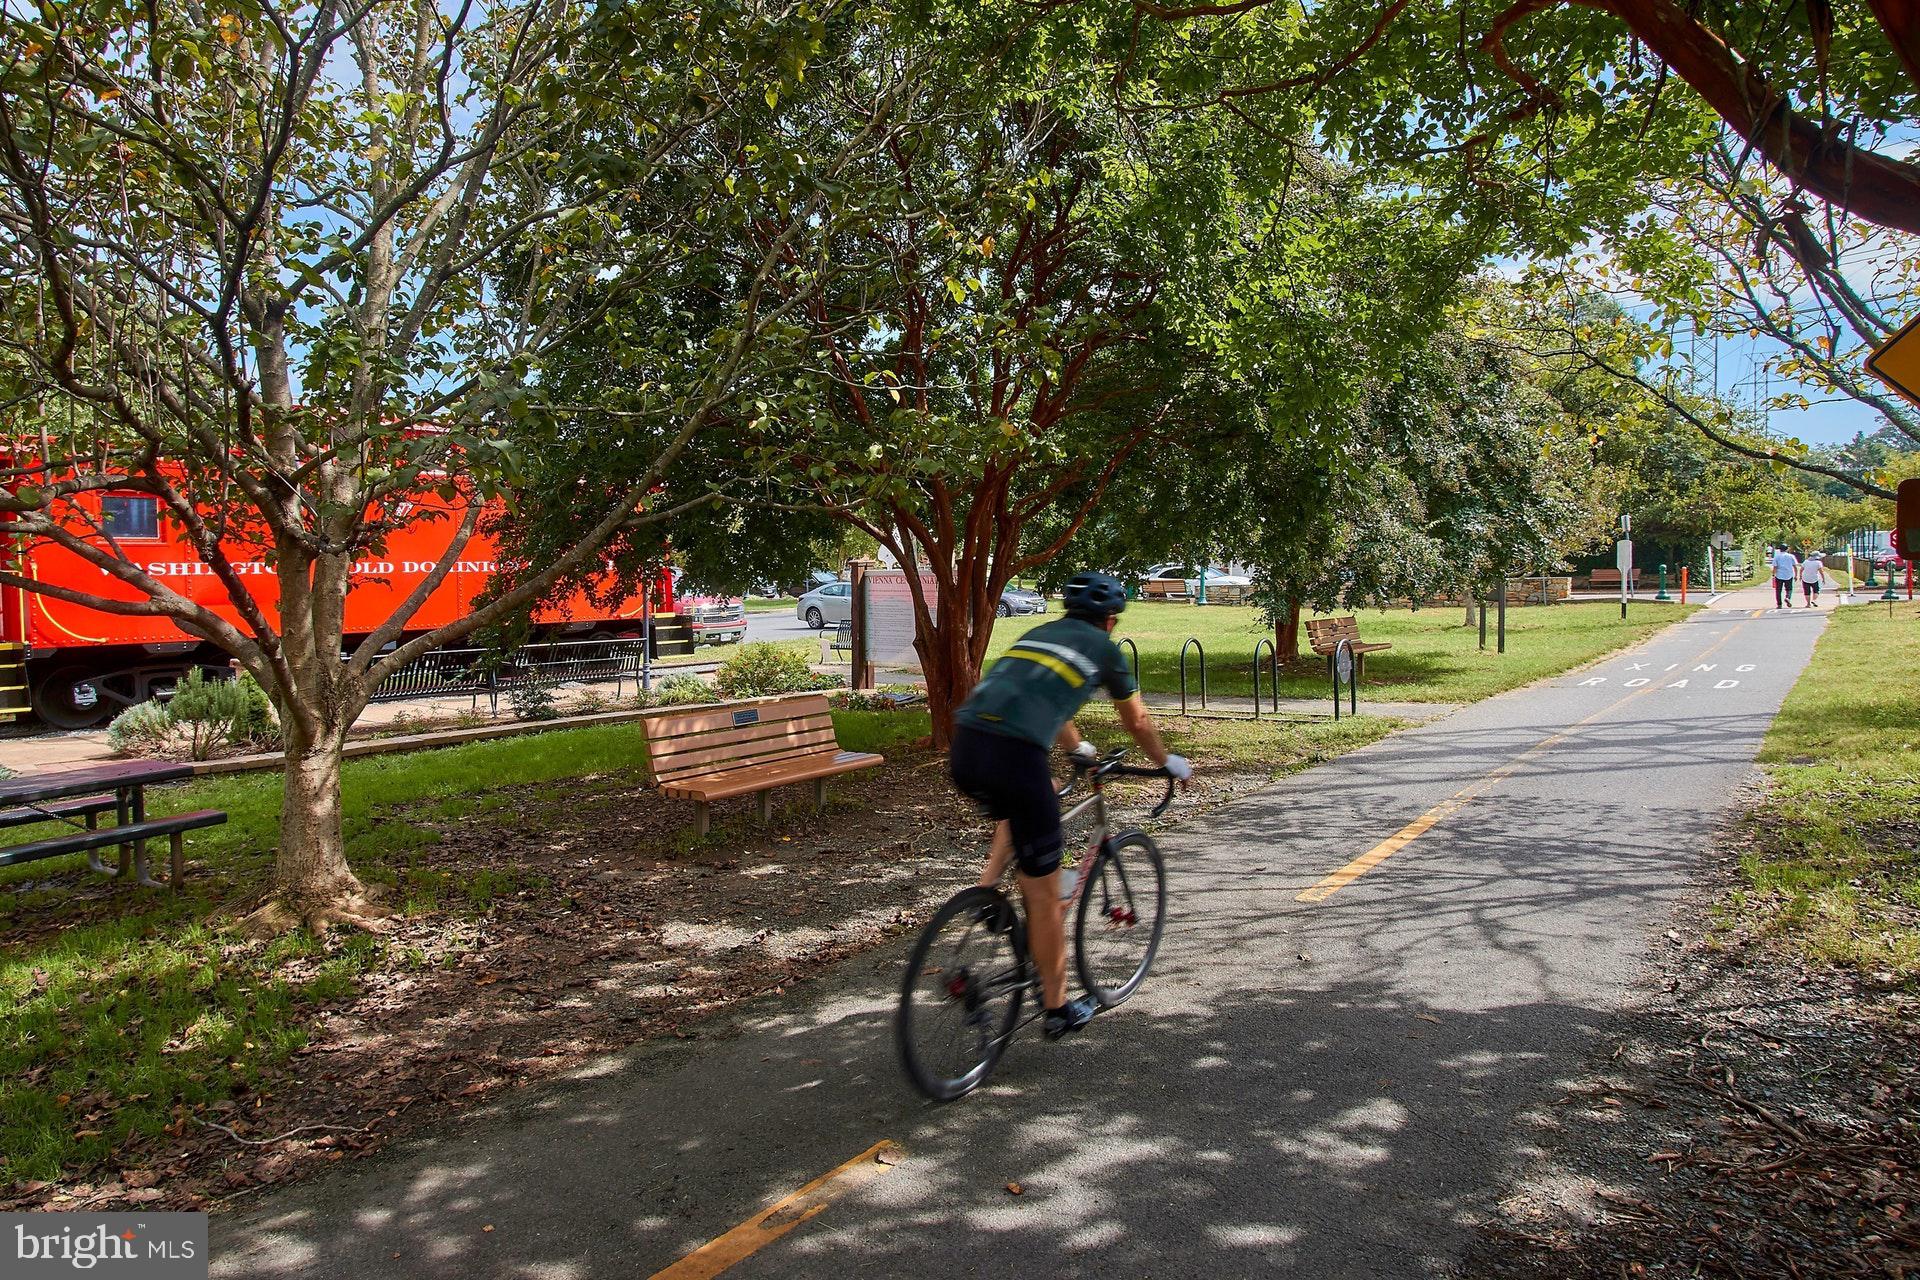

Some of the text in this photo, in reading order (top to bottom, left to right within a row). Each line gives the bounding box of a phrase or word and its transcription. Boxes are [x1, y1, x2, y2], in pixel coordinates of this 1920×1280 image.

[869, 576, 893, 584] VIENNA
[1624, 663, 1757, 672] XING
[1577, 677, 1740, 689] ROAD
